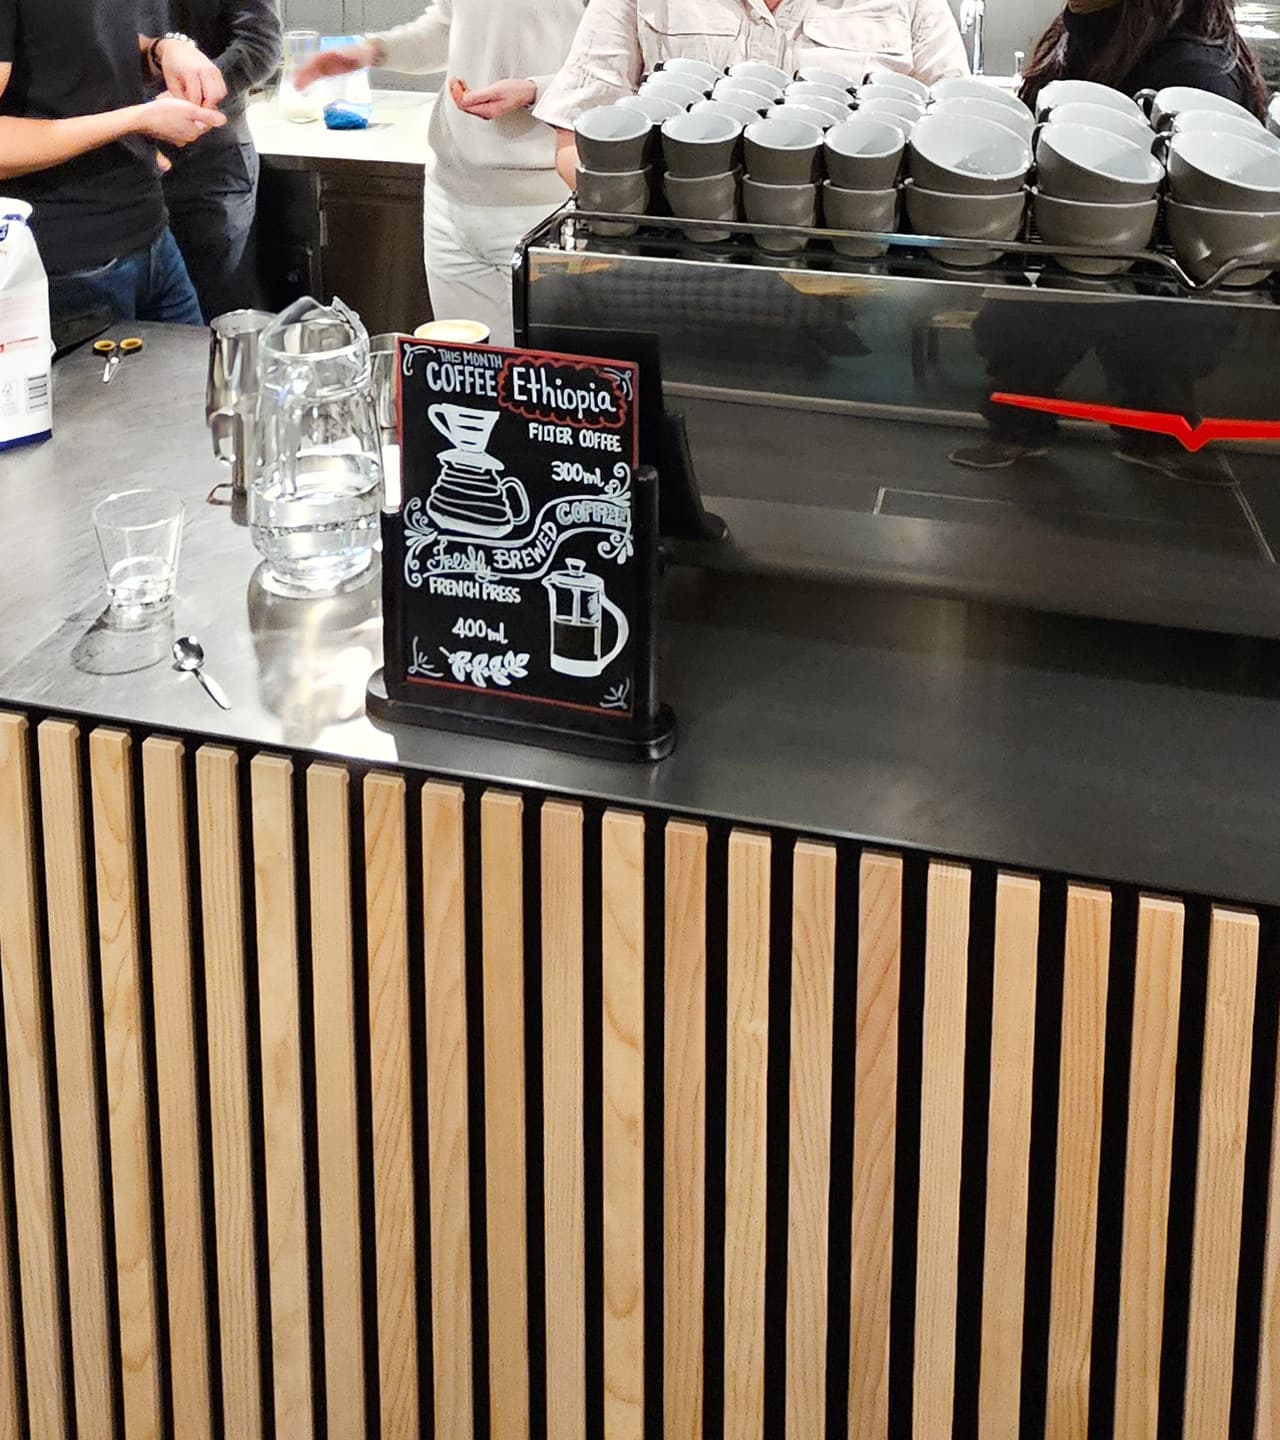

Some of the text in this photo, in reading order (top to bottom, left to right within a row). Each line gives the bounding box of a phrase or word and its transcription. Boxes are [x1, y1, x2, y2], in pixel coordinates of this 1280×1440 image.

[439, 349, 503, 369] THIS MONTH
[426, 361, 617, 420] COFFEE Ethiopia
[528, 421, 623, 453] FILTER COFFEE
[426, 500, 631, 583] Freshly BREWED COFFEE
[428, 576, 522, 604] FRENCH PRESS
